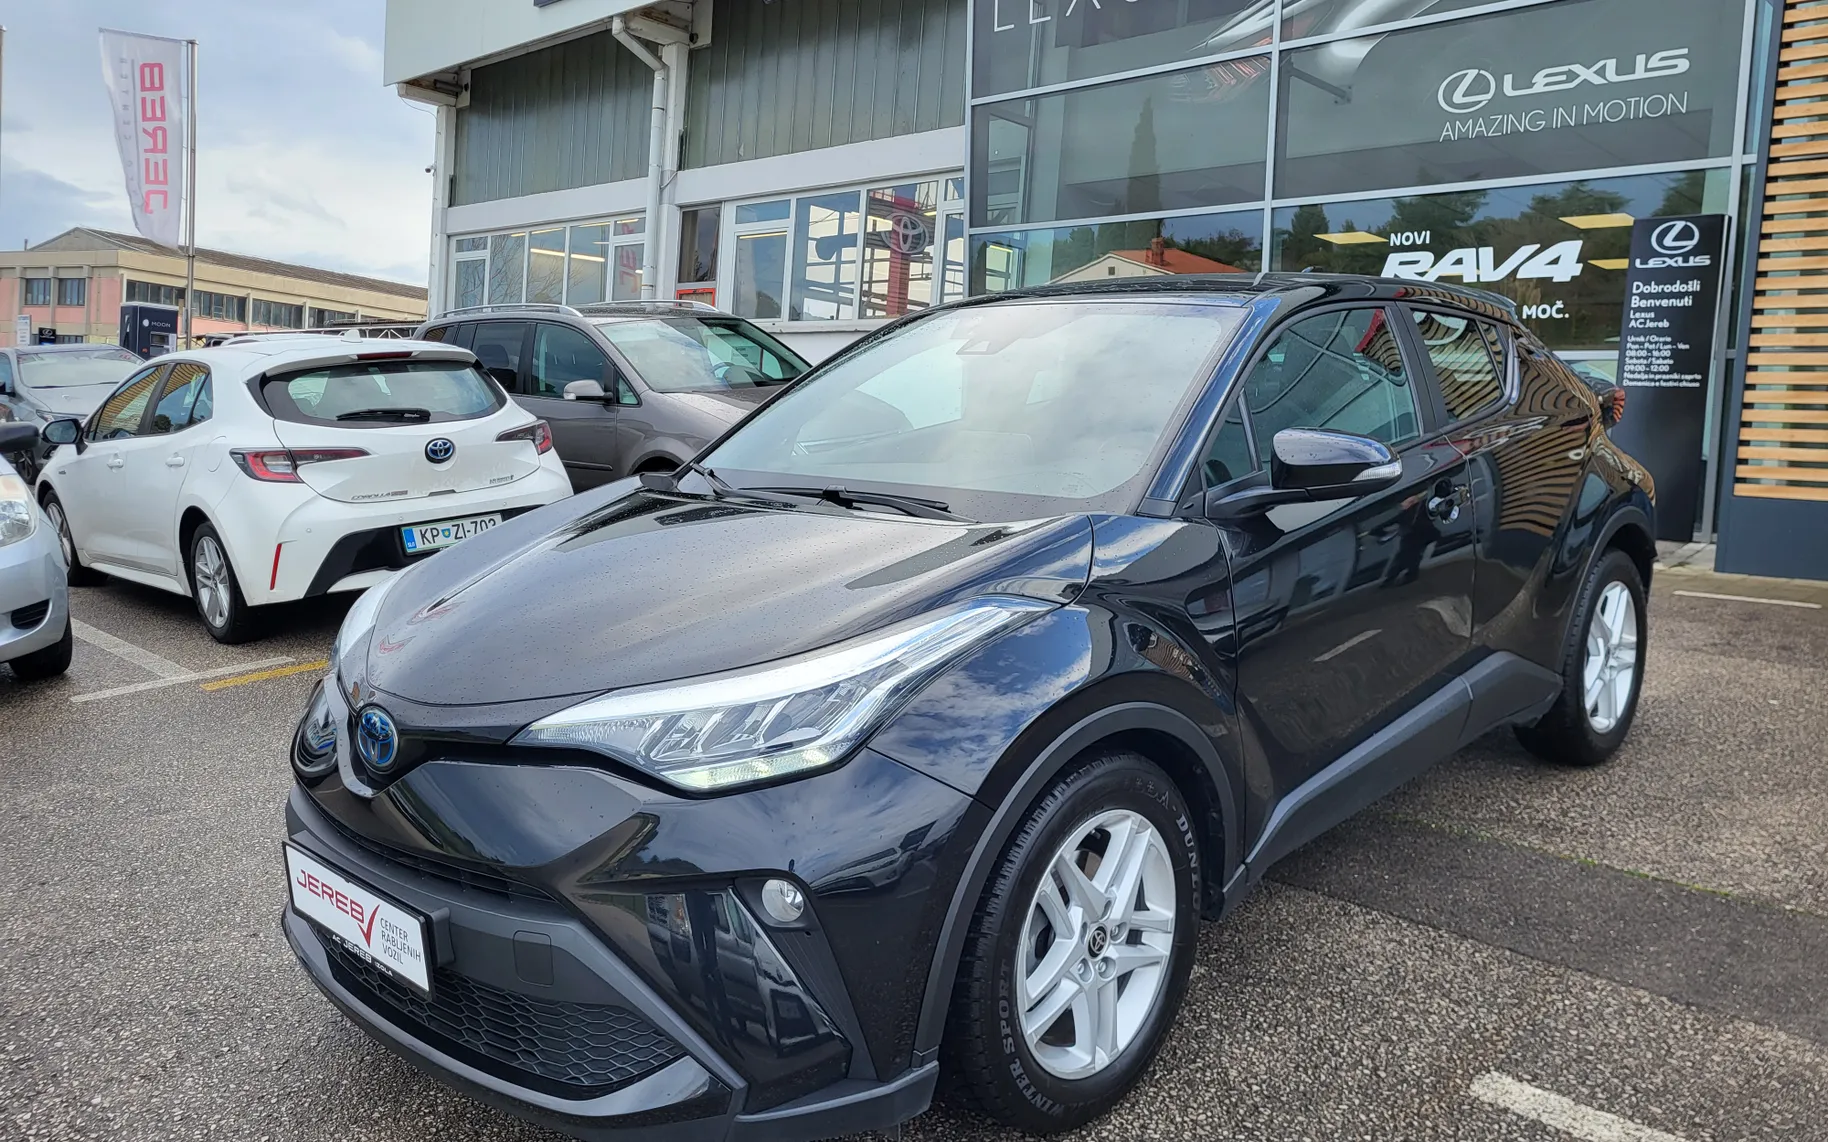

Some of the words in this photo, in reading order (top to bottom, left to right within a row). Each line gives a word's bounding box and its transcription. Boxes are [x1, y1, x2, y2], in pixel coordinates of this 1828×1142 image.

[1503, 47, 1690, 97] LEXUS
[1439, 109, 1546, 143] AMAZING
[1553, 105, 1577, 129] IN
[1583, 91, 1688, 126] MOTION
[1389, 230, 1431, 247] NOVI
[1380, 239, 1584, 283] RAV4
[1635, 254, 1712, 269] LEXUS
[1632, 279, 1702, 294] Dobrodošli
[1522, 300, 1570, 320] MOČ.
[1630, 295, 1693, 308] Benvenuti
[151, 320, 171, 328] MOON
[1629, 309, 1655, 319] Lexus
[420, 527, 440, 546] KP
[1175, 813, 1201, 920] DUNLO
[297, 869, 365, 925] JEREB
[380, 917, 408, 942] CENTER
[343, 940, 372, 964] JEREB
[381, 930, 421, 963] RABLJENIH
[382, 942, 404, 965] VOZIL
